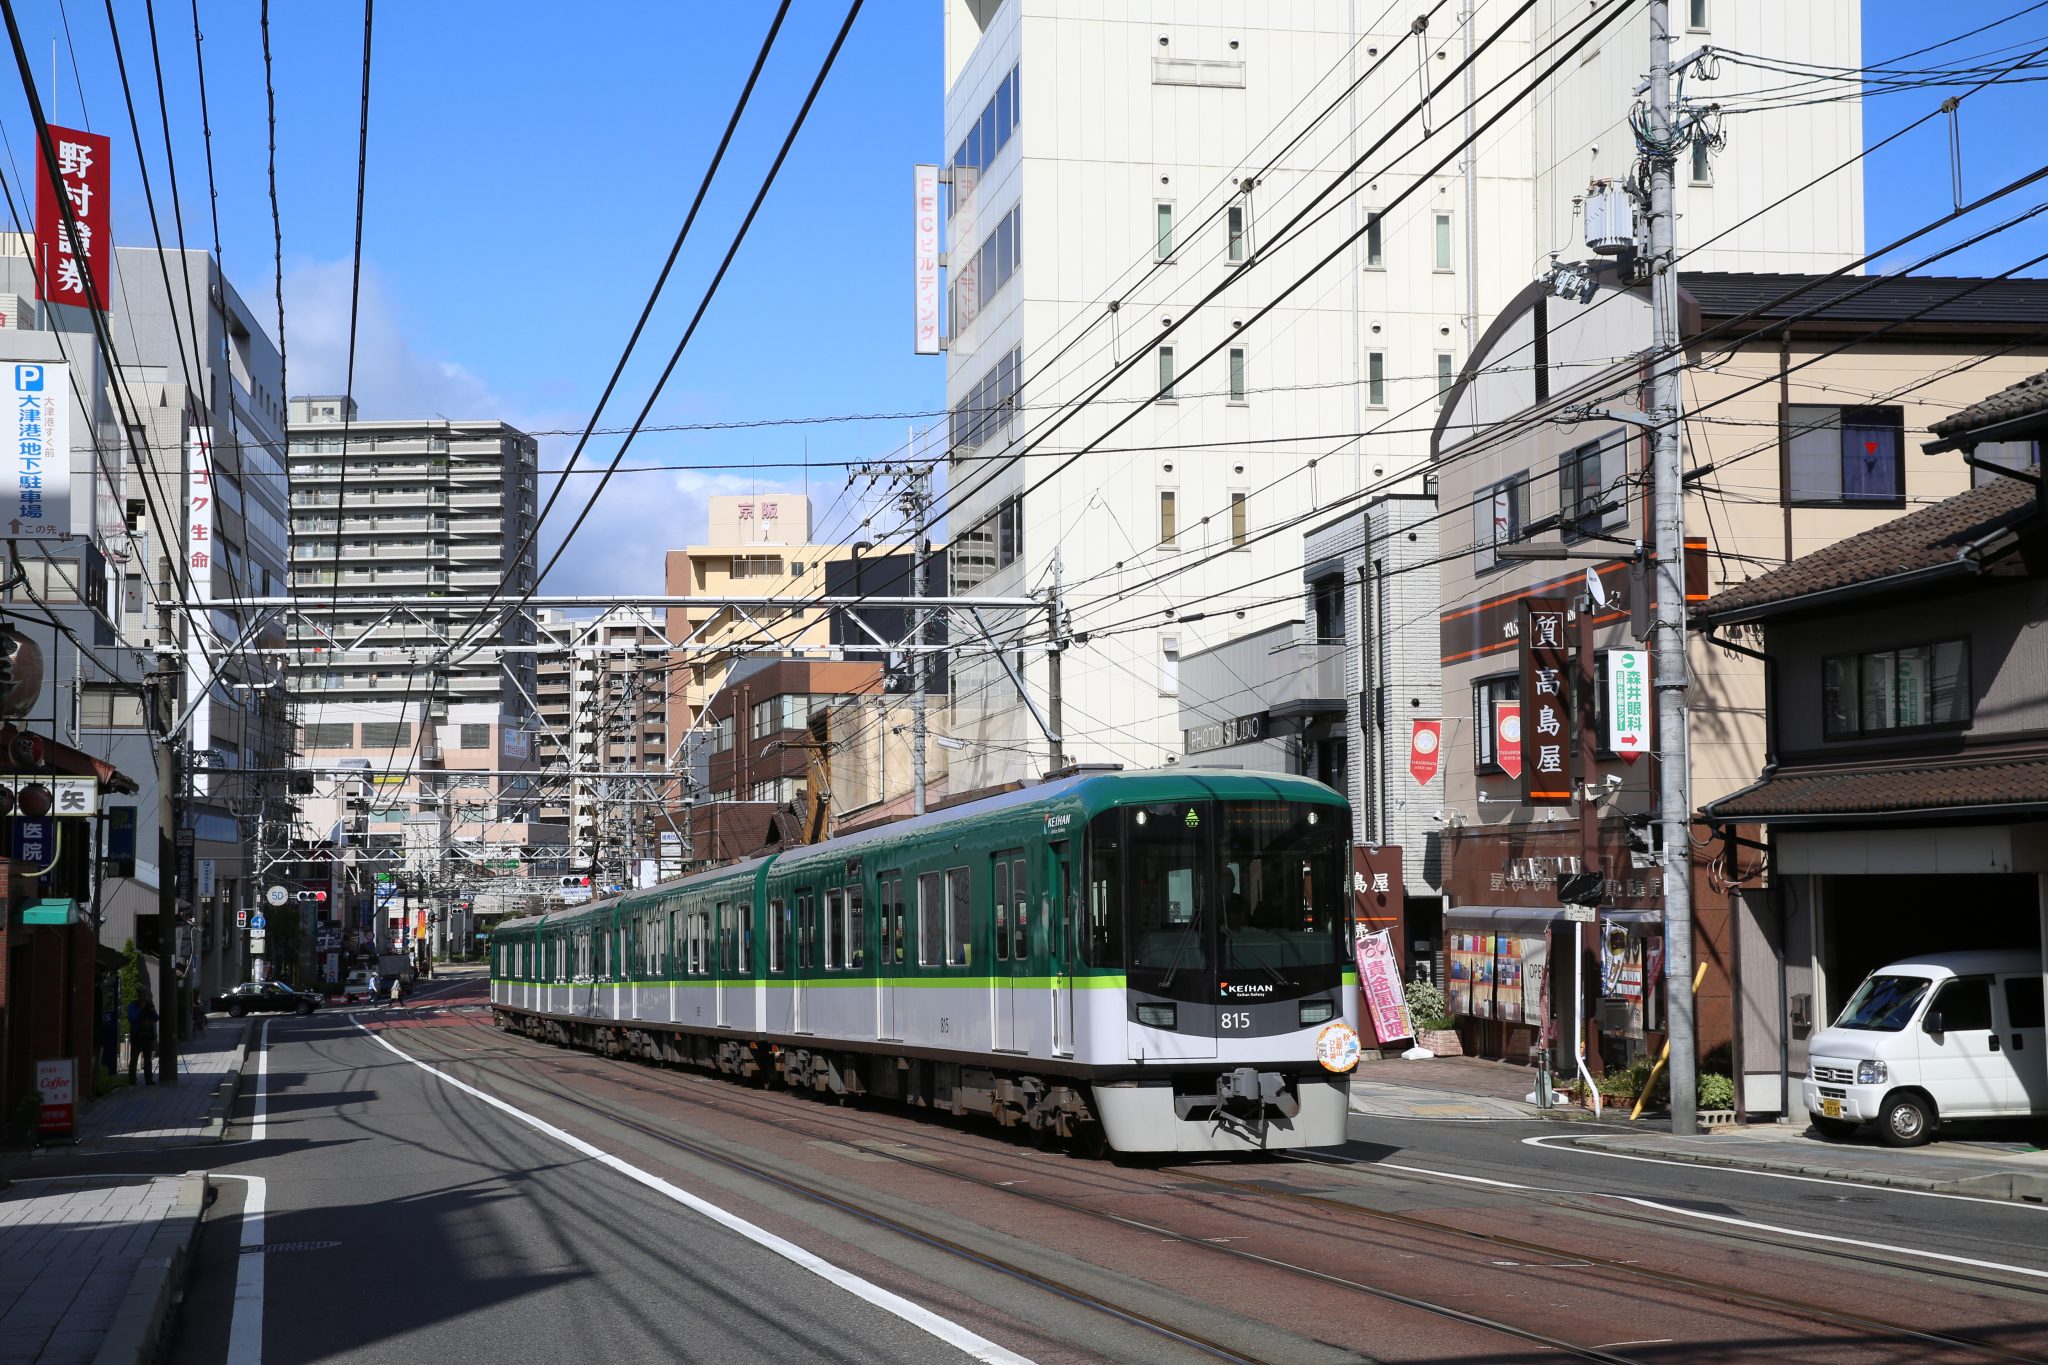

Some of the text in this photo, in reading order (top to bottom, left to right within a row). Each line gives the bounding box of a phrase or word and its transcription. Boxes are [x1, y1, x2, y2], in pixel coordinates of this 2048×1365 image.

[44, 397, 55, 458] 大津港すぐ前
[18, 394, 43, 519] 大津港(地下)駐車場
[191, 442, 210, 568] フコク生命
[738, 501, 779, 520] 京阪
[24, 524, 58, 535] この先
[1626, 670, 1642, 732] 森井眼科
[1535, 667, 1563, 774] 高島屋
[1190, 716, 1259, 750] PHOTO STUDIO
[1047, 814, 1071, 828] KEIHAN
[22, 821, 44, 861] 医院
[271, 891, 284, 901] 50
[1228, 984, 1273, 993] KEIHAN
[940, 1017, 950, 1034] 815
[1221, 1012, 1251, 1029] 815
[40, 1076, 71, 1090] Coffee
